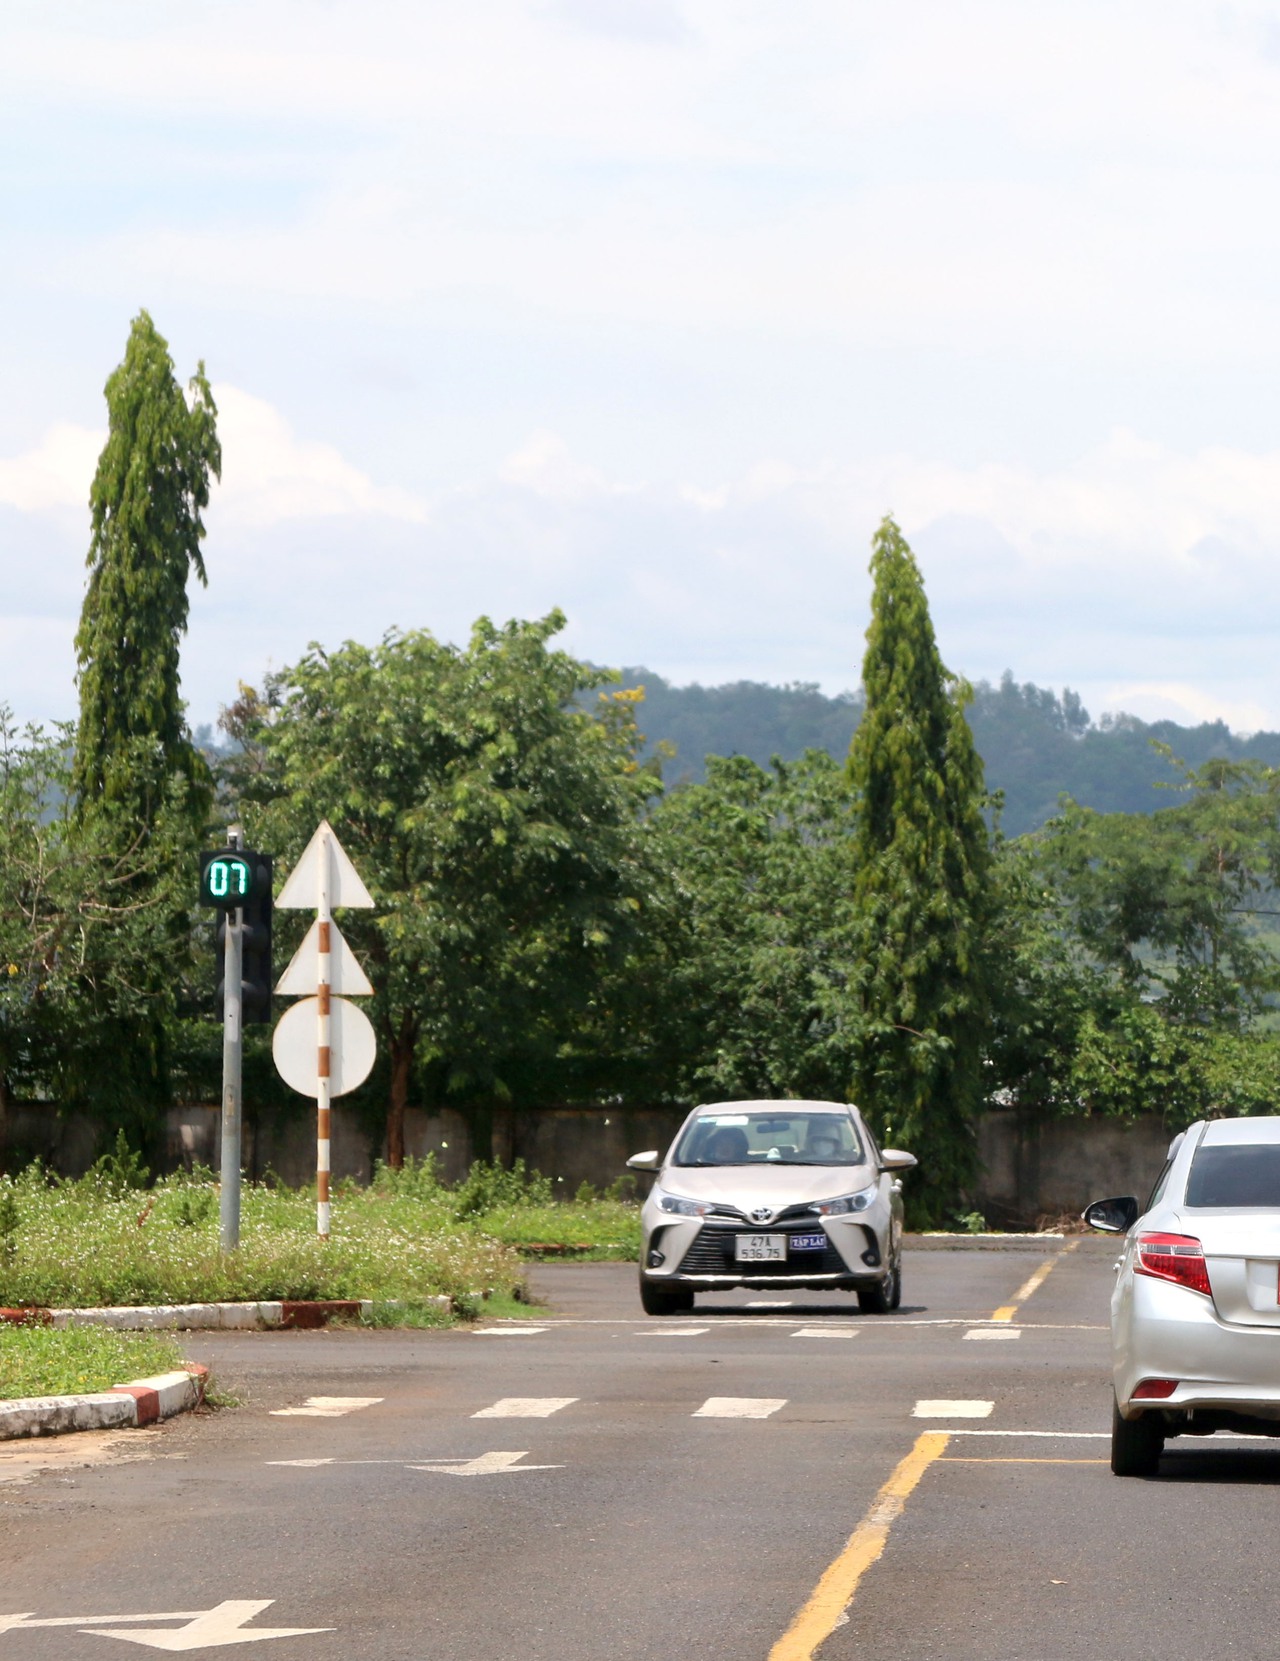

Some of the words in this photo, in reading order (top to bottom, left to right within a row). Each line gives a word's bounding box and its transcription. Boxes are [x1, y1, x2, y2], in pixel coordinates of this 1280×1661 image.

[210, 862, 246, 896] 07
[750, 1236, 771, 1247] 47A
[741, 1248, 780, 1259] 536.75
